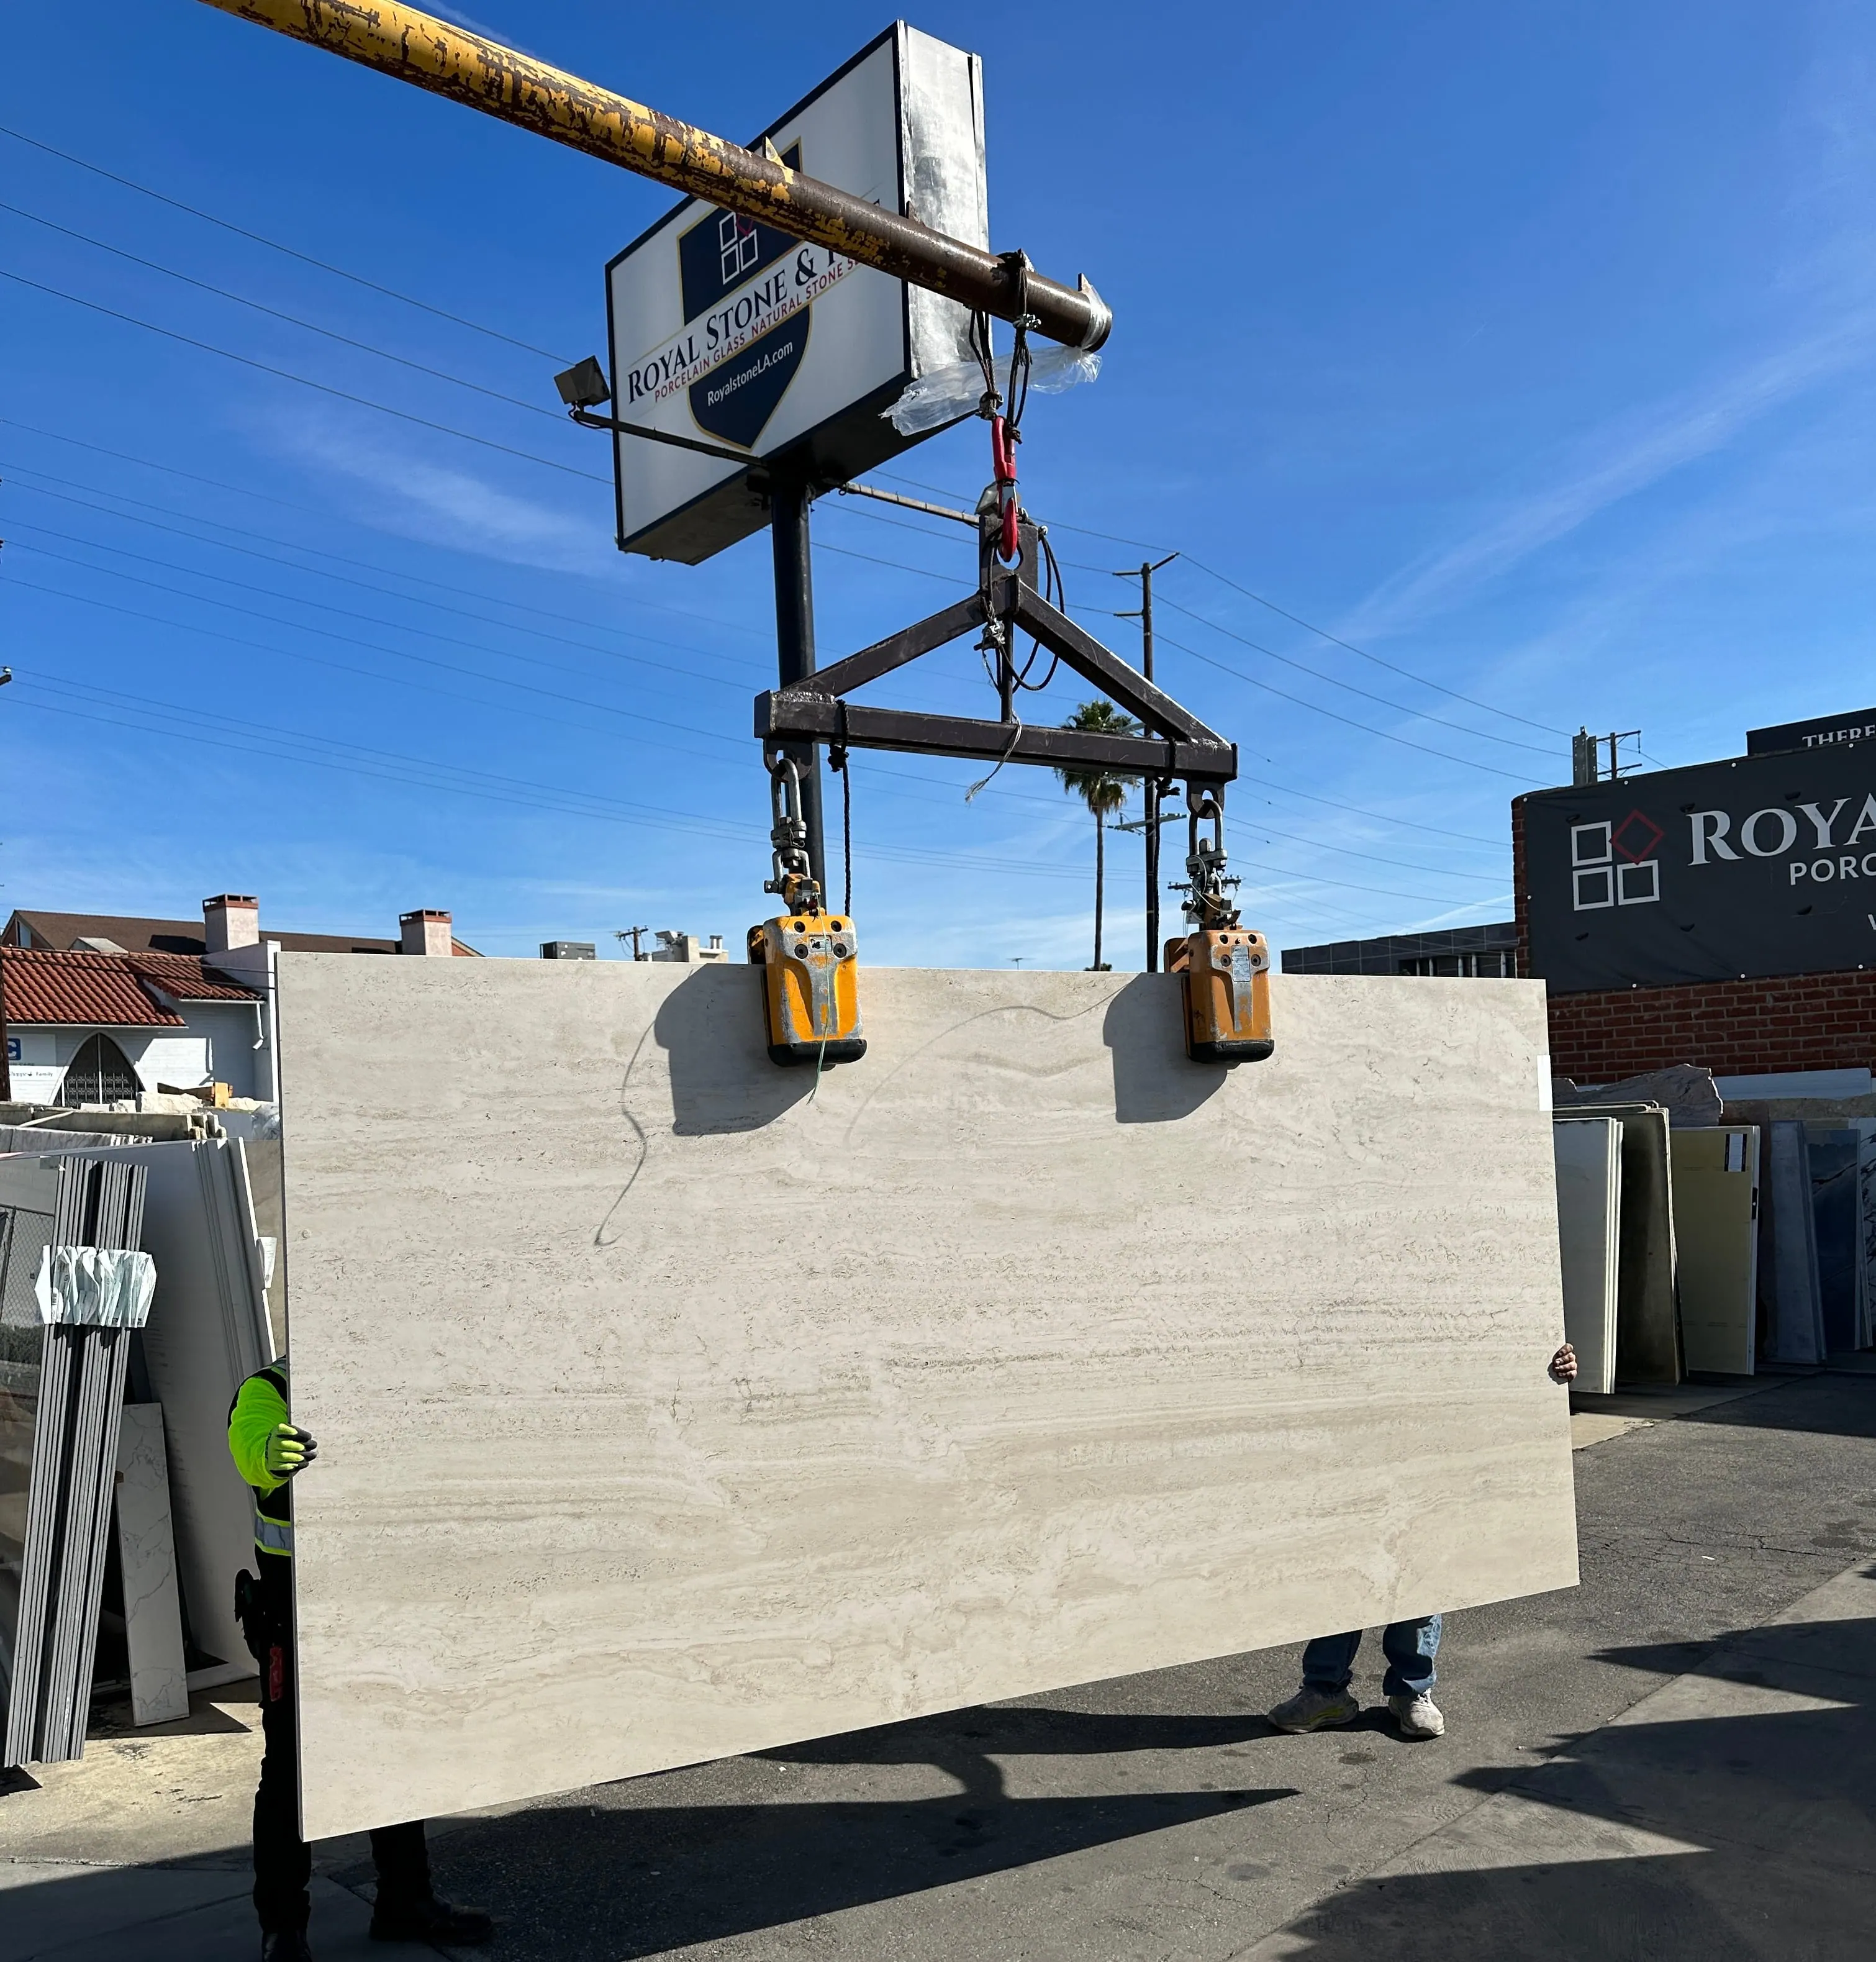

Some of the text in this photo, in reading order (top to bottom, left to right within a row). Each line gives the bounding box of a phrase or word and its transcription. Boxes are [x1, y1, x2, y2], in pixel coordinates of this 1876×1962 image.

[627, 248, 818, 404] ROYAL STONE &
[655, 262, 843, 403] PORCELAIN GLASS NATURAL STONE
[707, 342, 794, 407] RoyalstoneLA.com
